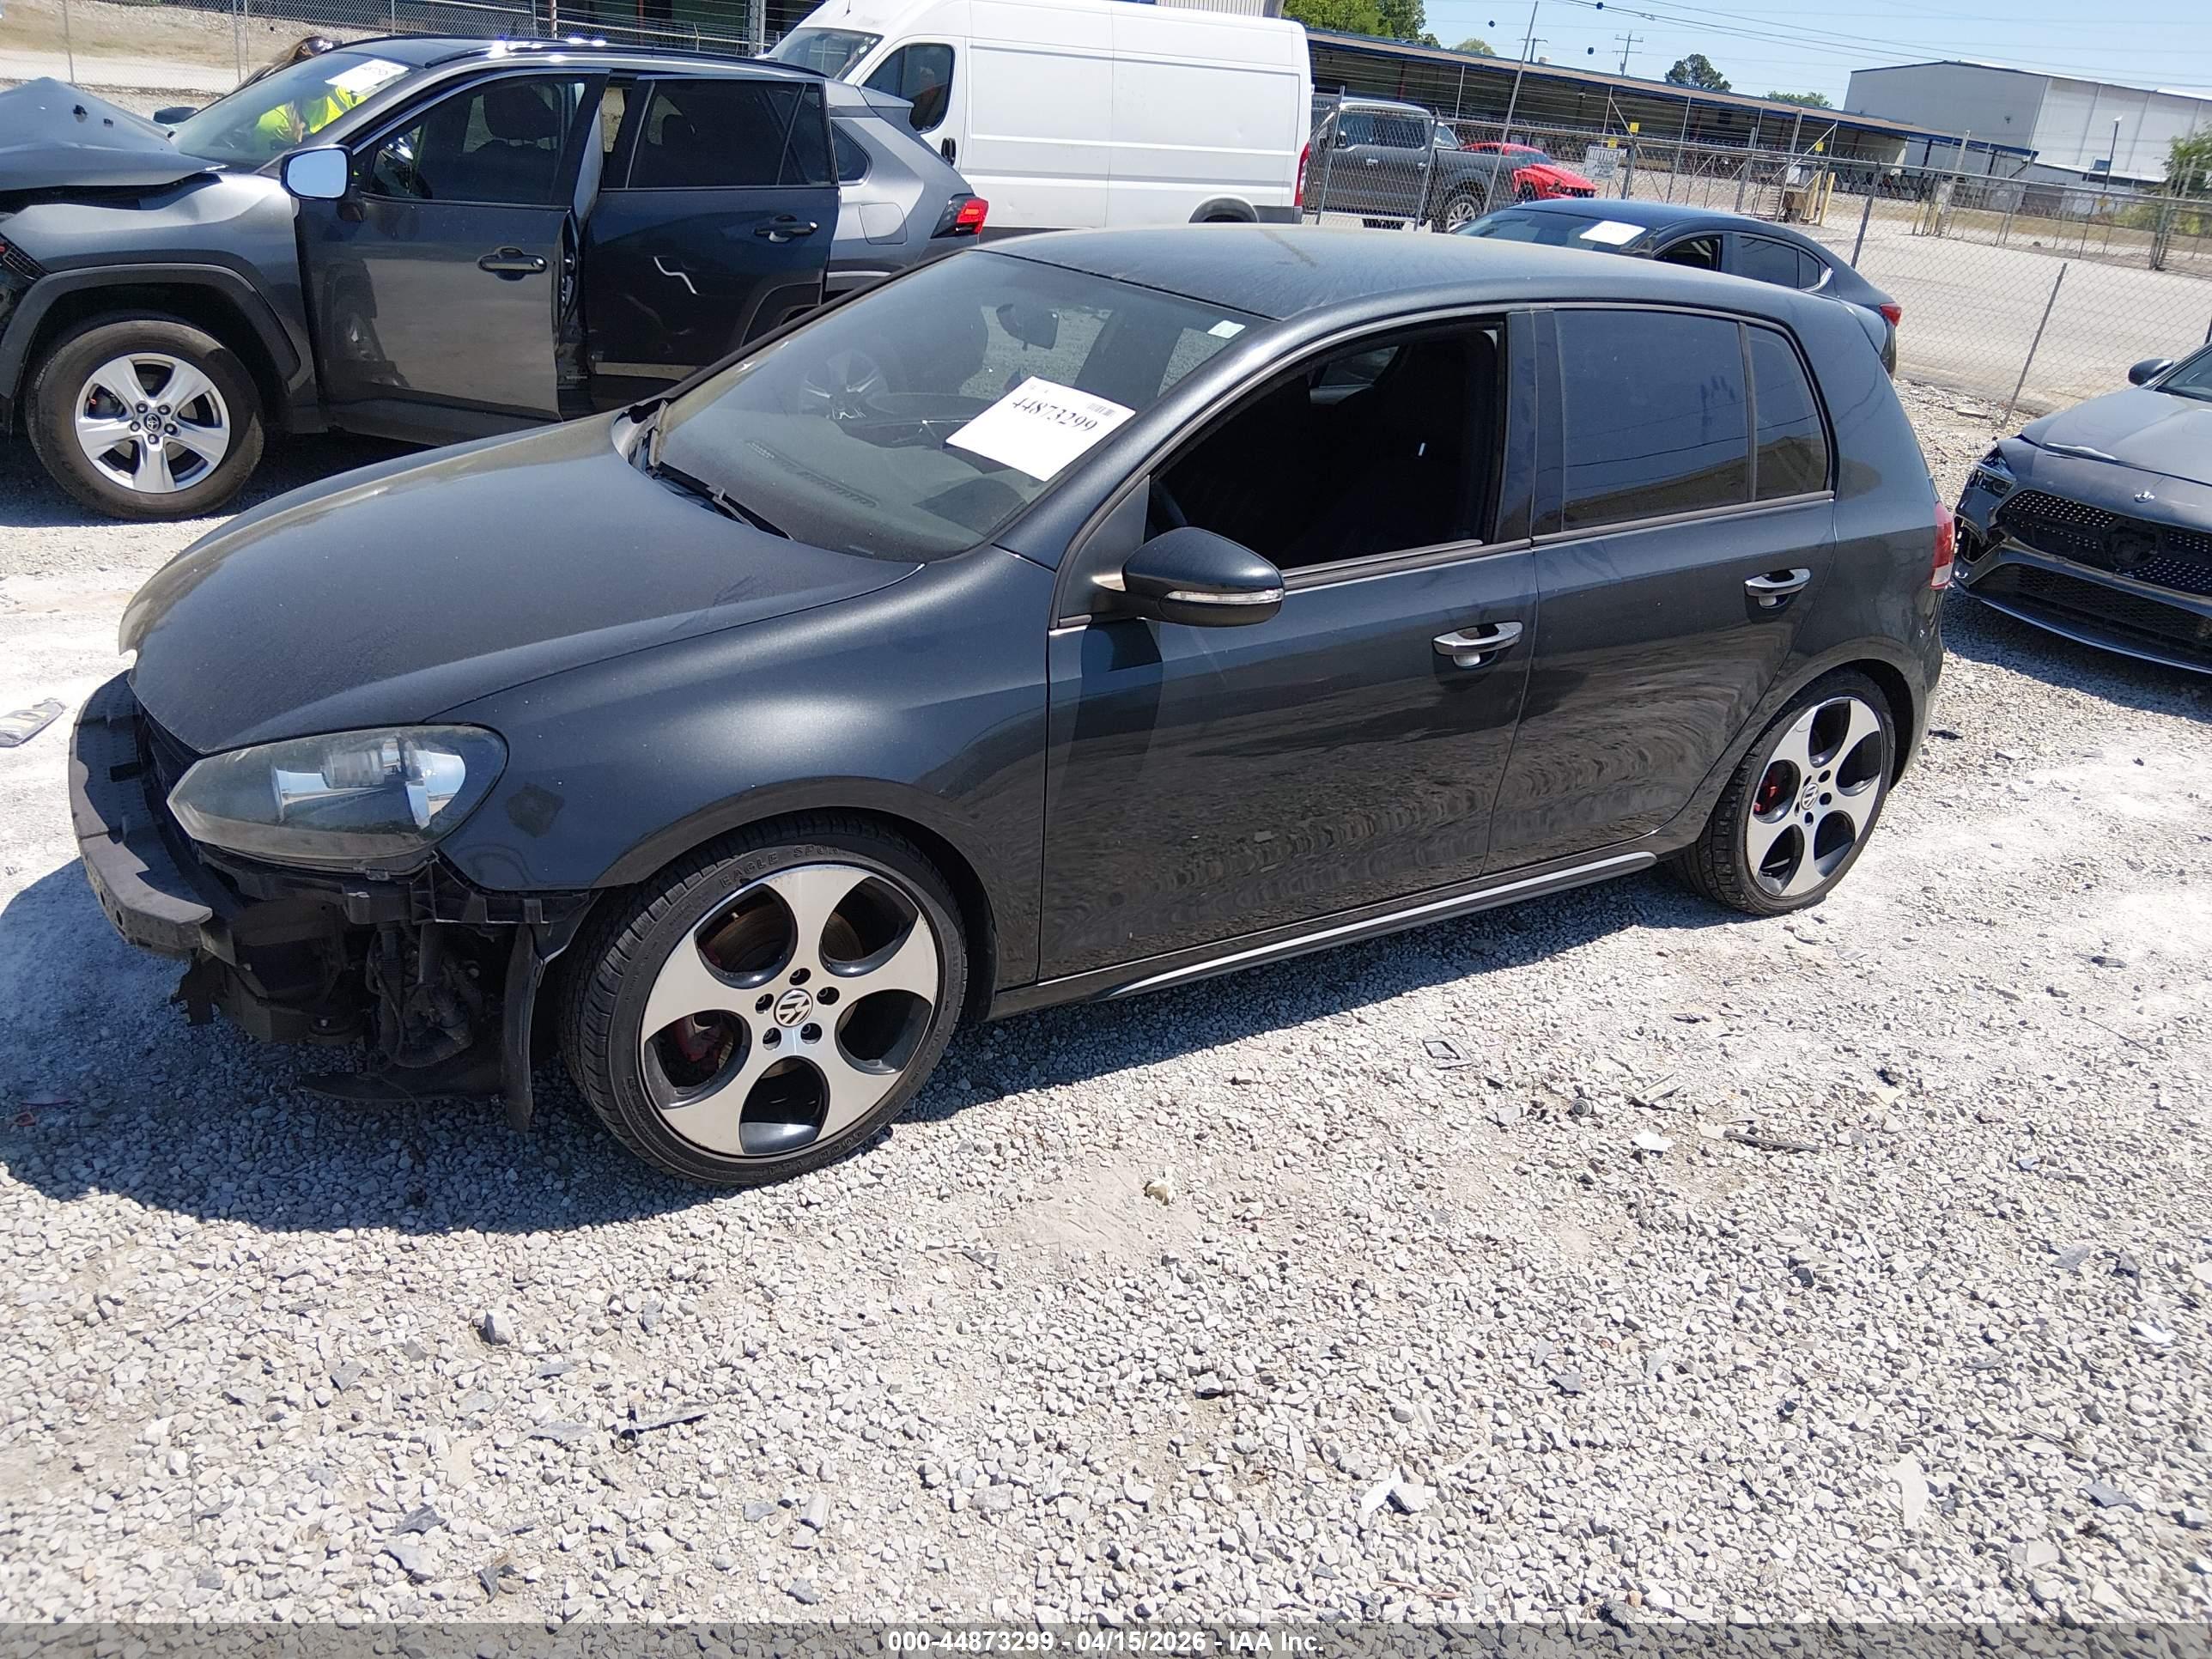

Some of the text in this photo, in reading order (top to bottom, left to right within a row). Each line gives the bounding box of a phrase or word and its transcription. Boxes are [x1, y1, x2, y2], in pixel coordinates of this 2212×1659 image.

[1589, 148, 1620, 162] NOTICE
[1012, 397, 1098, 432] 44873299
[720, 851, 779, 888] EAGLE
